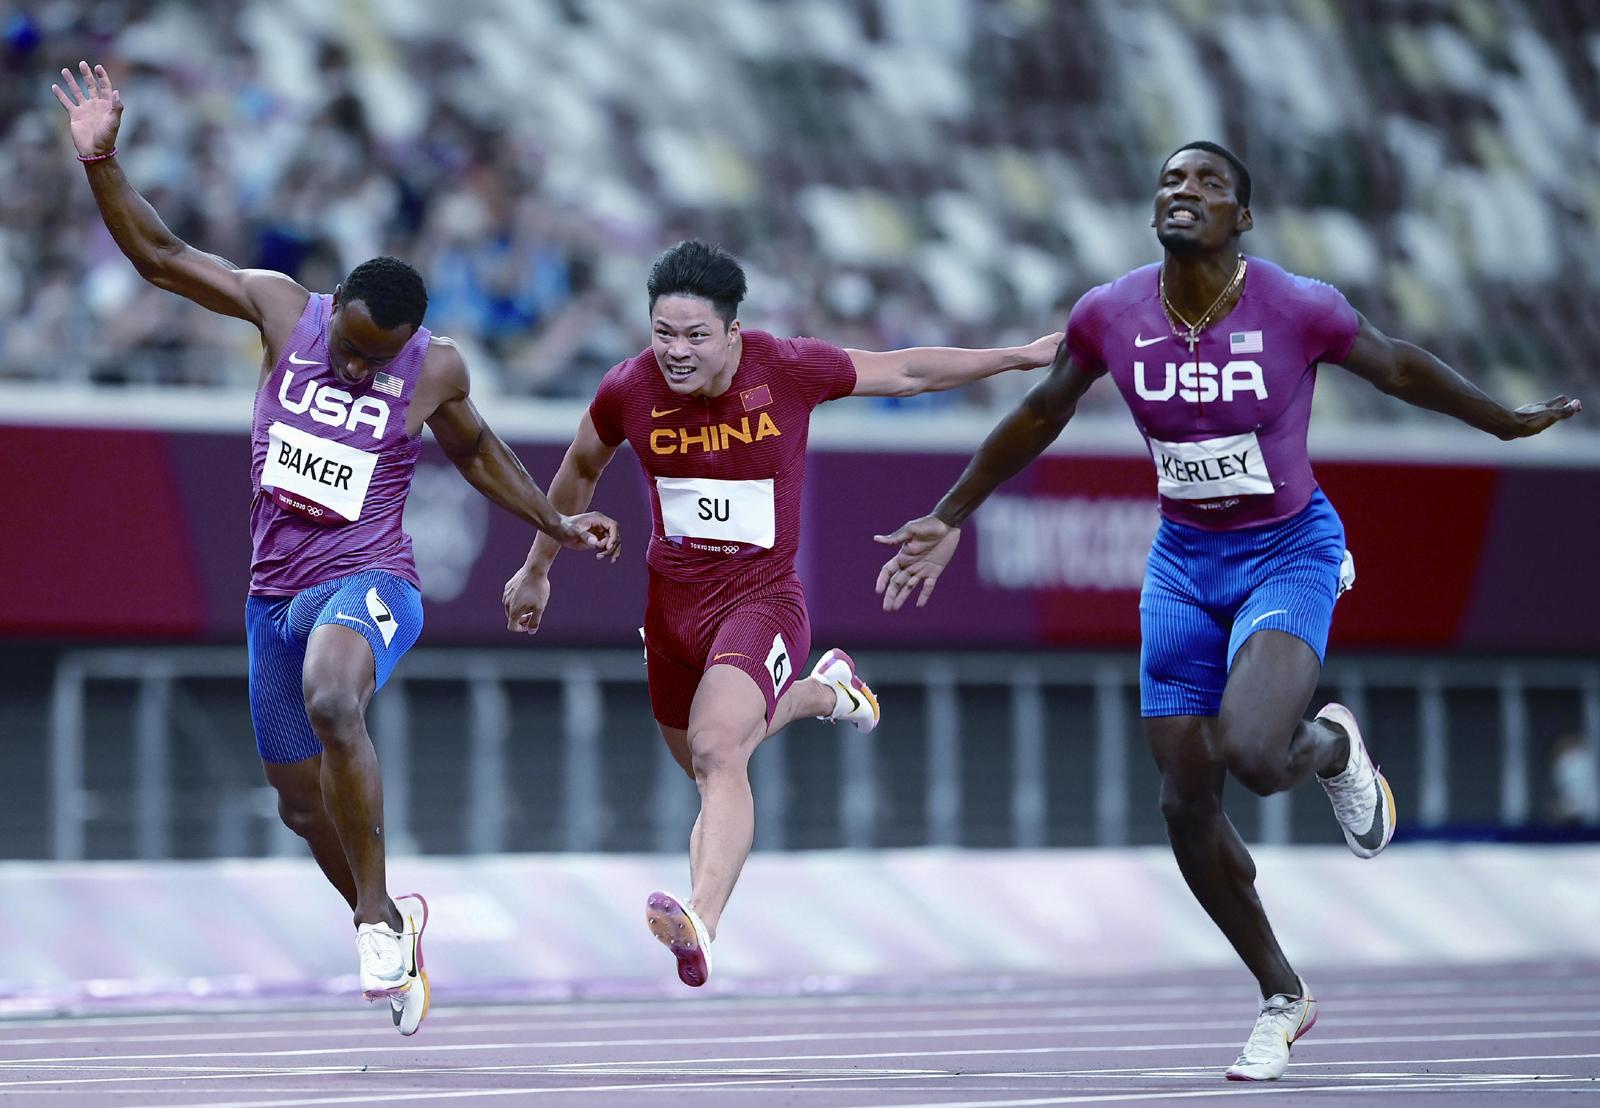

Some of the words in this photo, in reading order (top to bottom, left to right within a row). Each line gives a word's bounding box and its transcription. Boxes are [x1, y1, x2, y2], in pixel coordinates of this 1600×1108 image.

[1133, 360, 1268, 402] USA
[278, 369, 391, 440] USA
[650, 412, 782, 455] CHINA
[277, 440, 353, 490] BAKER
[1161, 451, 1248, 482] KERLEY
[697, 497, 730, 522] SU
[690, 542, 708, 551] TOKYO
[773, 652, 787, 687] 6
